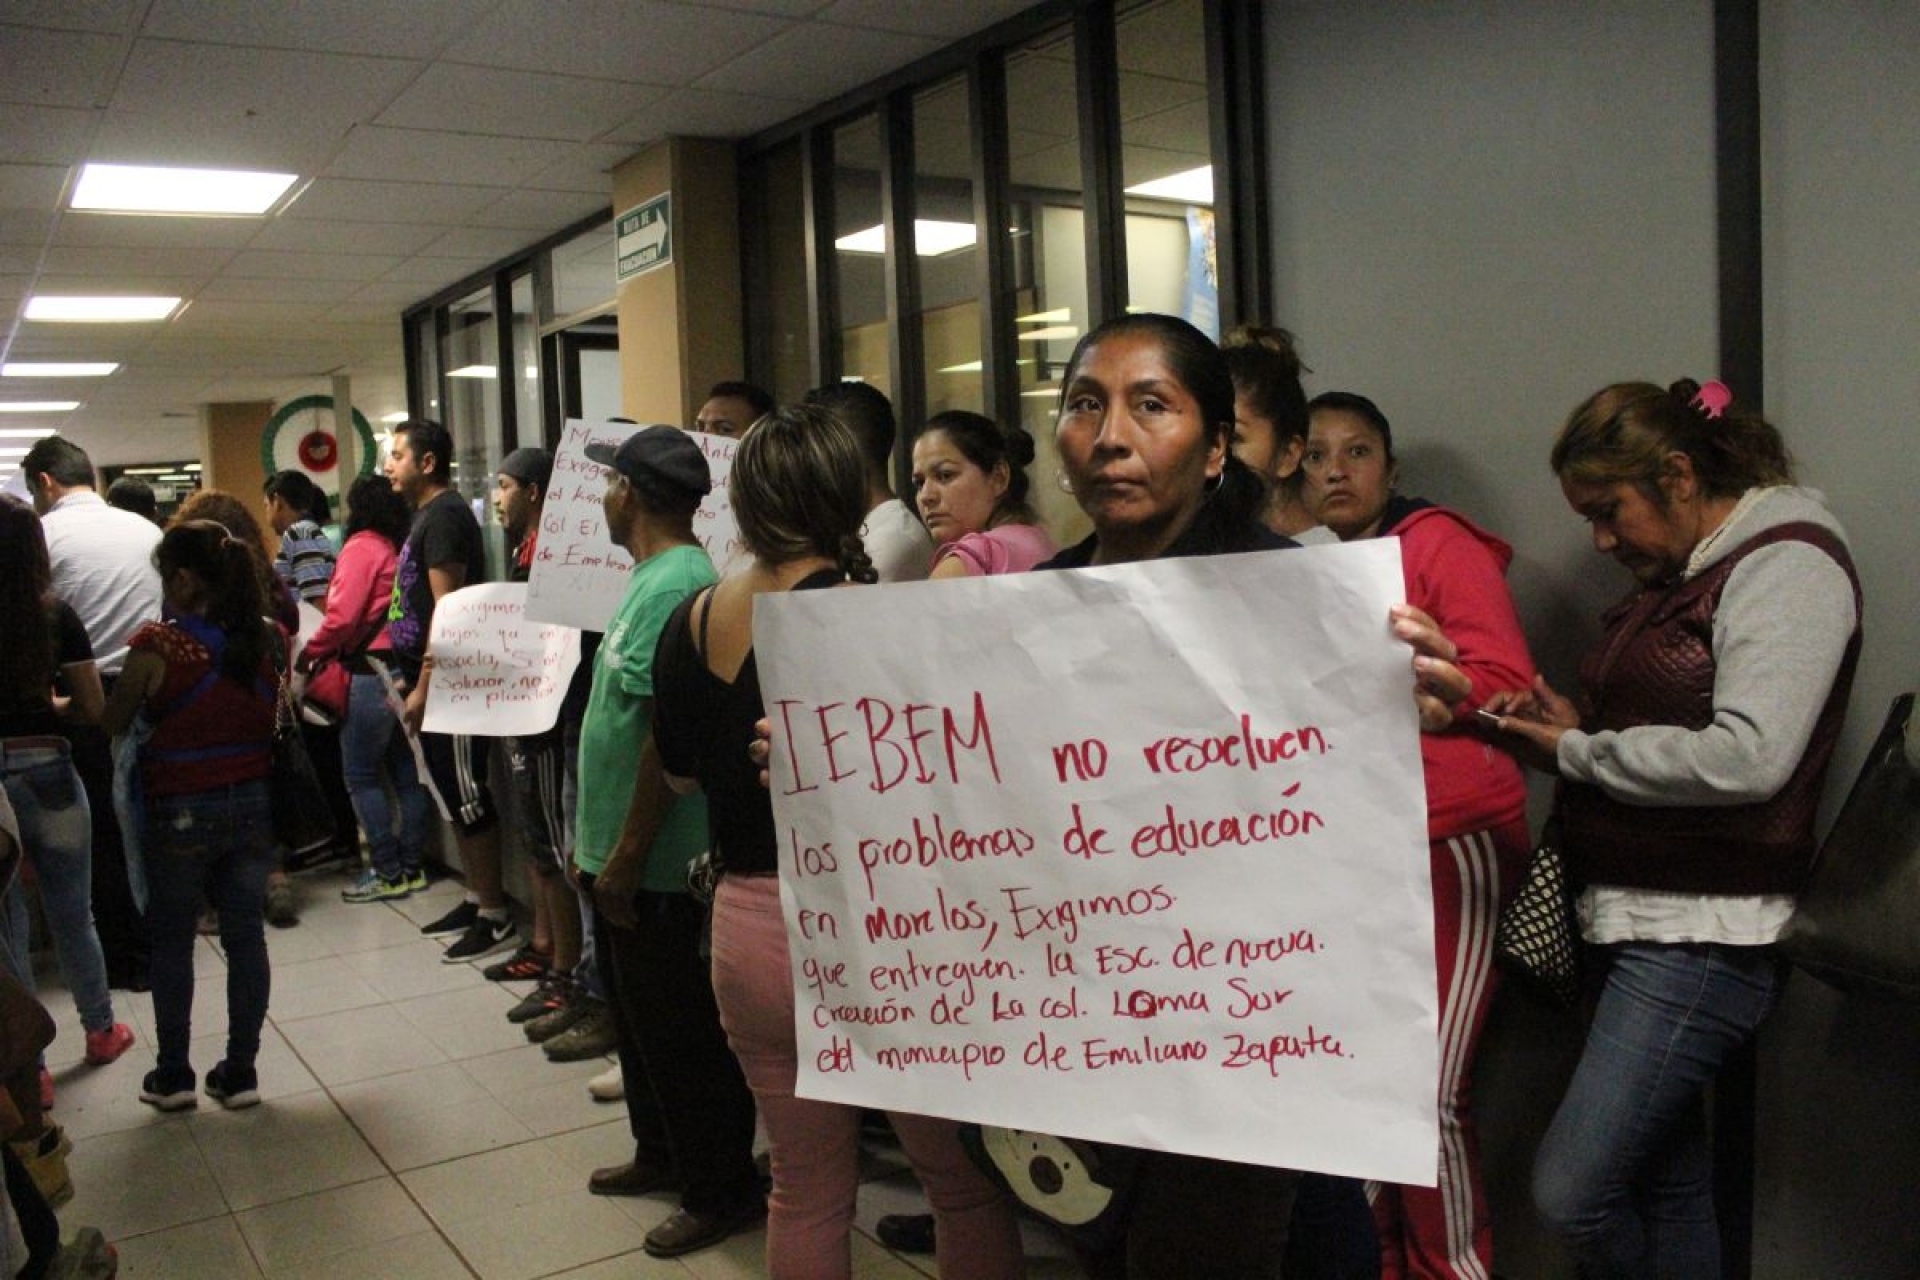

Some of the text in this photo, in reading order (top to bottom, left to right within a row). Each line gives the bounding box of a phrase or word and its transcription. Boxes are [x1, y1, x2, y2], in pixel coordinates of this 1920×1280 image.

[773, 691, 1002, 795] IEBEM
[1052, 738, 1108, 783] no
[791, 782, 1324, 901] los problemas de educación
[799, 909, 838, 940] en
[803, 957, 848, 1001] que
[1047, 942, 1078, 977] la
[1172, 928, 1217, 970] de
[930, 993, 970, 1025] de
[1113, 990, 1210, 1019] Loma
[1226, 977, 1293, 1018] Sur
[876, 1042, 1006, 1081] municipio
[1023, 1031, 1074, 1071] de
[1082, 1036, 1208, 1070] Emiliano
